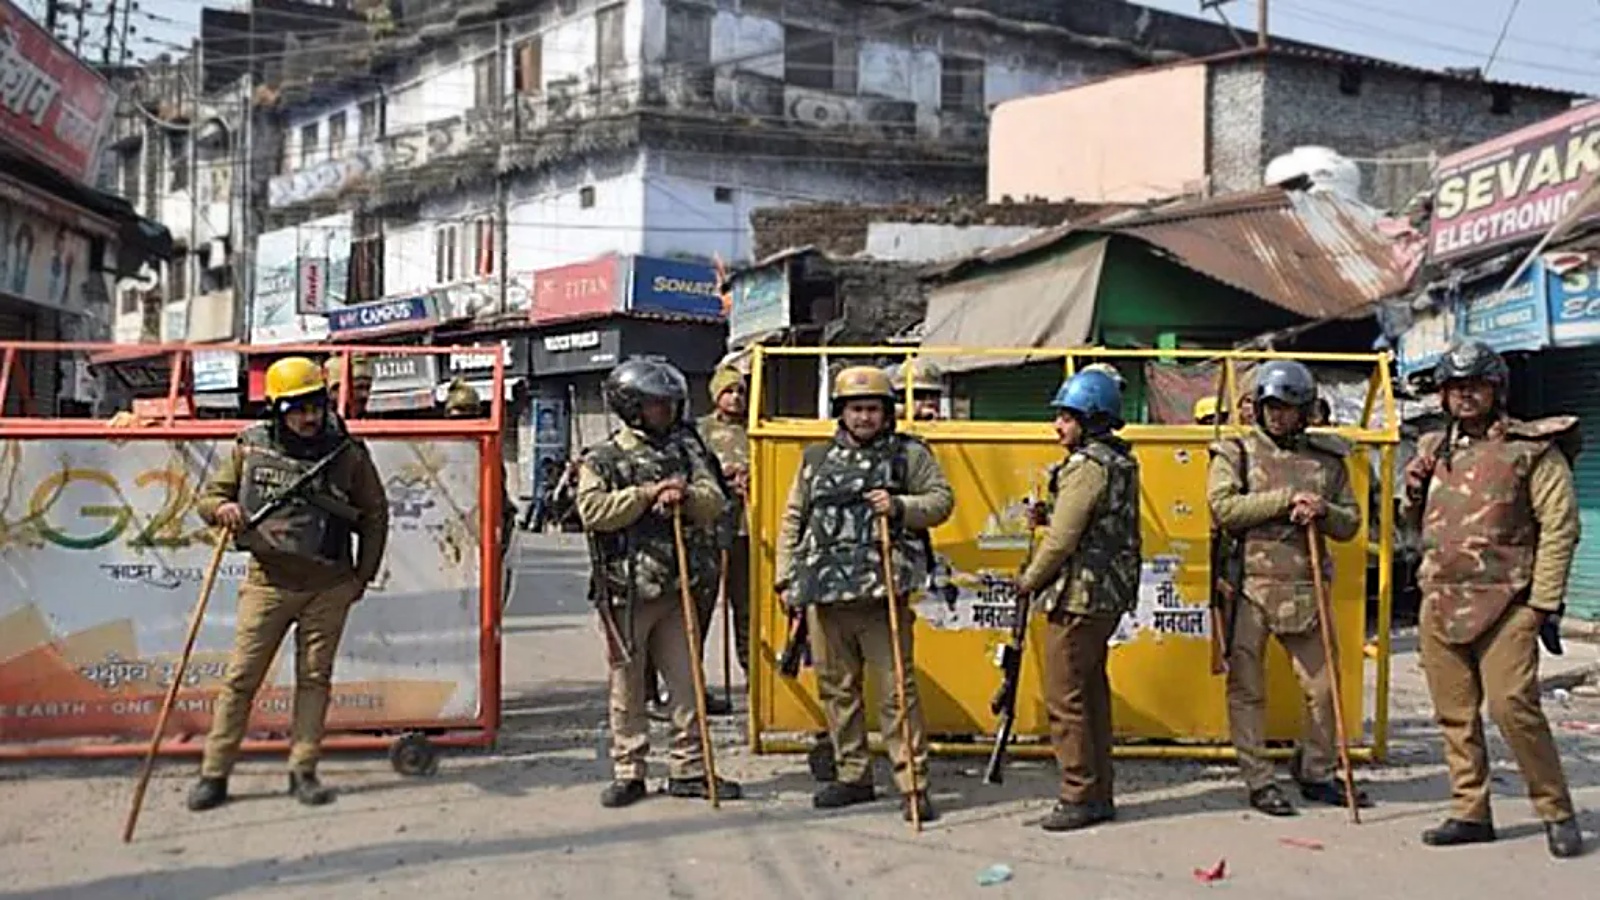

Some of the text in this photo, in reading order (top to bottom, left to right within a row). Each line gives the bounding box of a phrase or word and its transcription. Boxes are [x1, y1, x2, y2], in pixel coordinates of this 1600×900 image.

[1438, 131, 1600, 219] SEVAK
[565, 276, 608, 299] TITAN
[361, 302, 411, 325] CAMPUS
[29, 467, 191, 550] G2
[16, 701, 86, 718] EARTH
